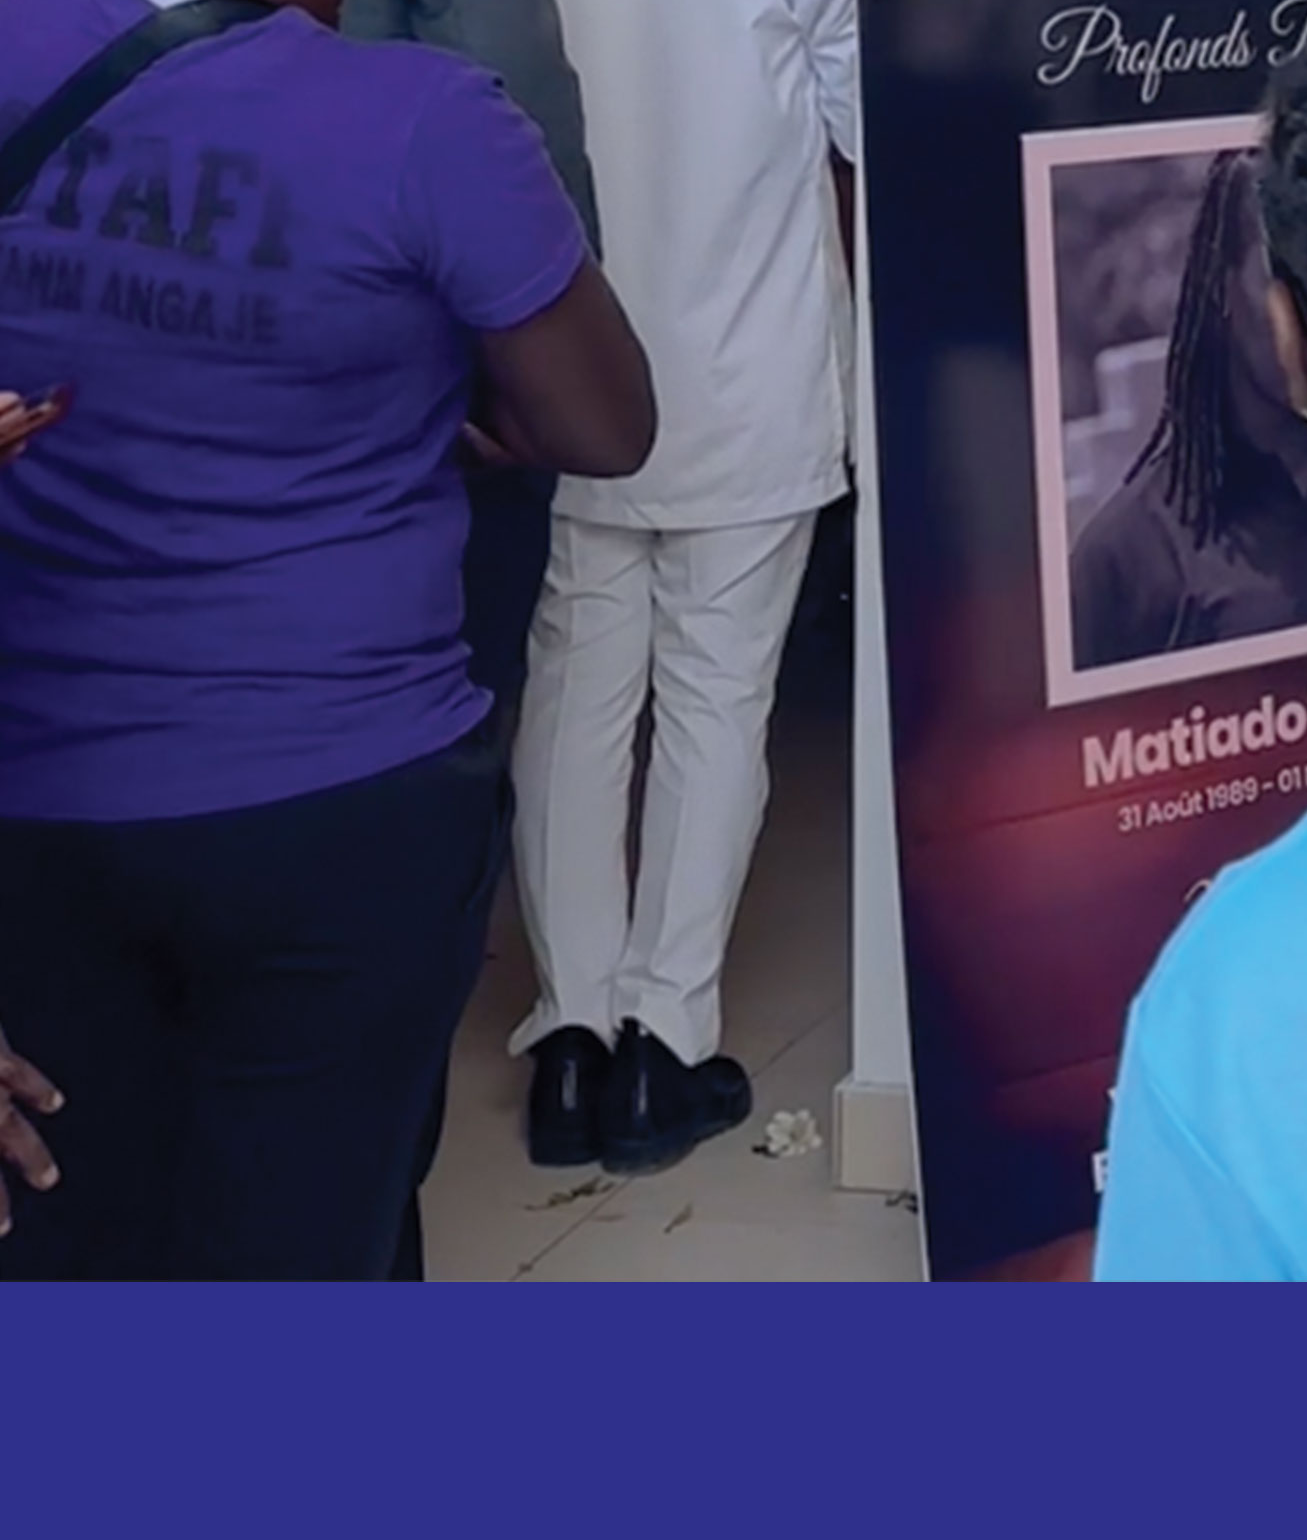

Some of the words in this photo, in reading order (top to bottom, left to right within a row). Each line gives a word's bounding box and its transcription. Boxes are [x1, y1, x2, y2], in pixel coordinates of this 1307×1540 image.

[1036, 2, 1254, 104] Profonds
[99, 266, 283, 346] ANGAJE
[1082, 696, 1307, 788] Matiado
[1117, 810, 1142, 832] 31
[1146, 789, 1205, 828] Août
[1207, 778, 1260, 813] 1989
[1278, 767, 1302, 793] 01
